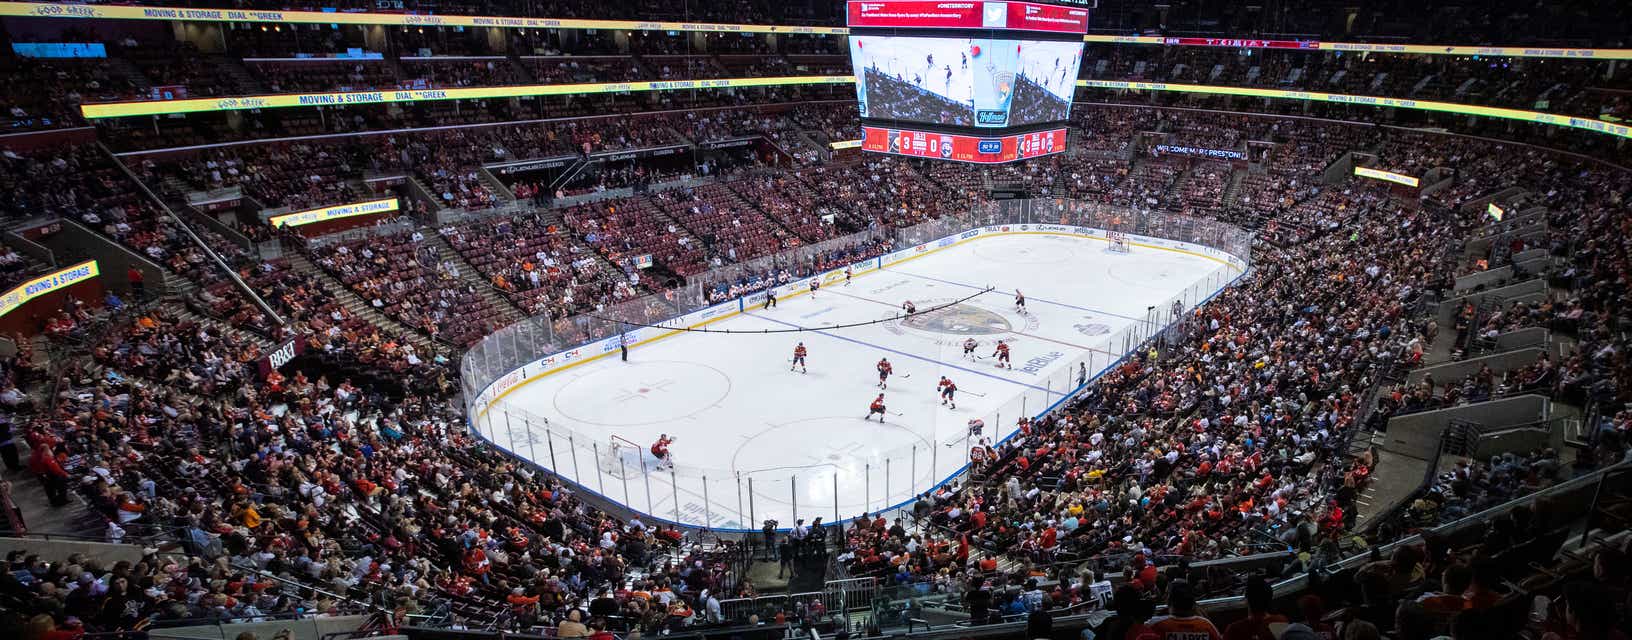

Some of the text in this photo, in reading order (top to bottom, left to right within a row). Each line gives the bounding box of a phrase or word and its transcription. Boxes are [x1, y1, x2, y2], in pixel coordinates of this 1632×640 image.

[144, 8, 177, 18] MOVING
[186, 10, 223, 19] STORAGE
[228, 11, 248, 19] DIAL
[300, 95, 335, 104] MOVING
[345, 92, 383, 103] STORAGE
[395, 91, 413, 100] DIAL
[903, 136, 910, 150] 3
[930, 139, 937, 152] 0
[1025, 137, 1046, 152] 3 0
[327, 207, 353, 217] MOVING
[361, 202, 390, 212] STORAGE
[25, 278, 51, 296] MOVING
[59, 265, 91, 285] STORAGE
[268, 340, 296, 370] BB&T
